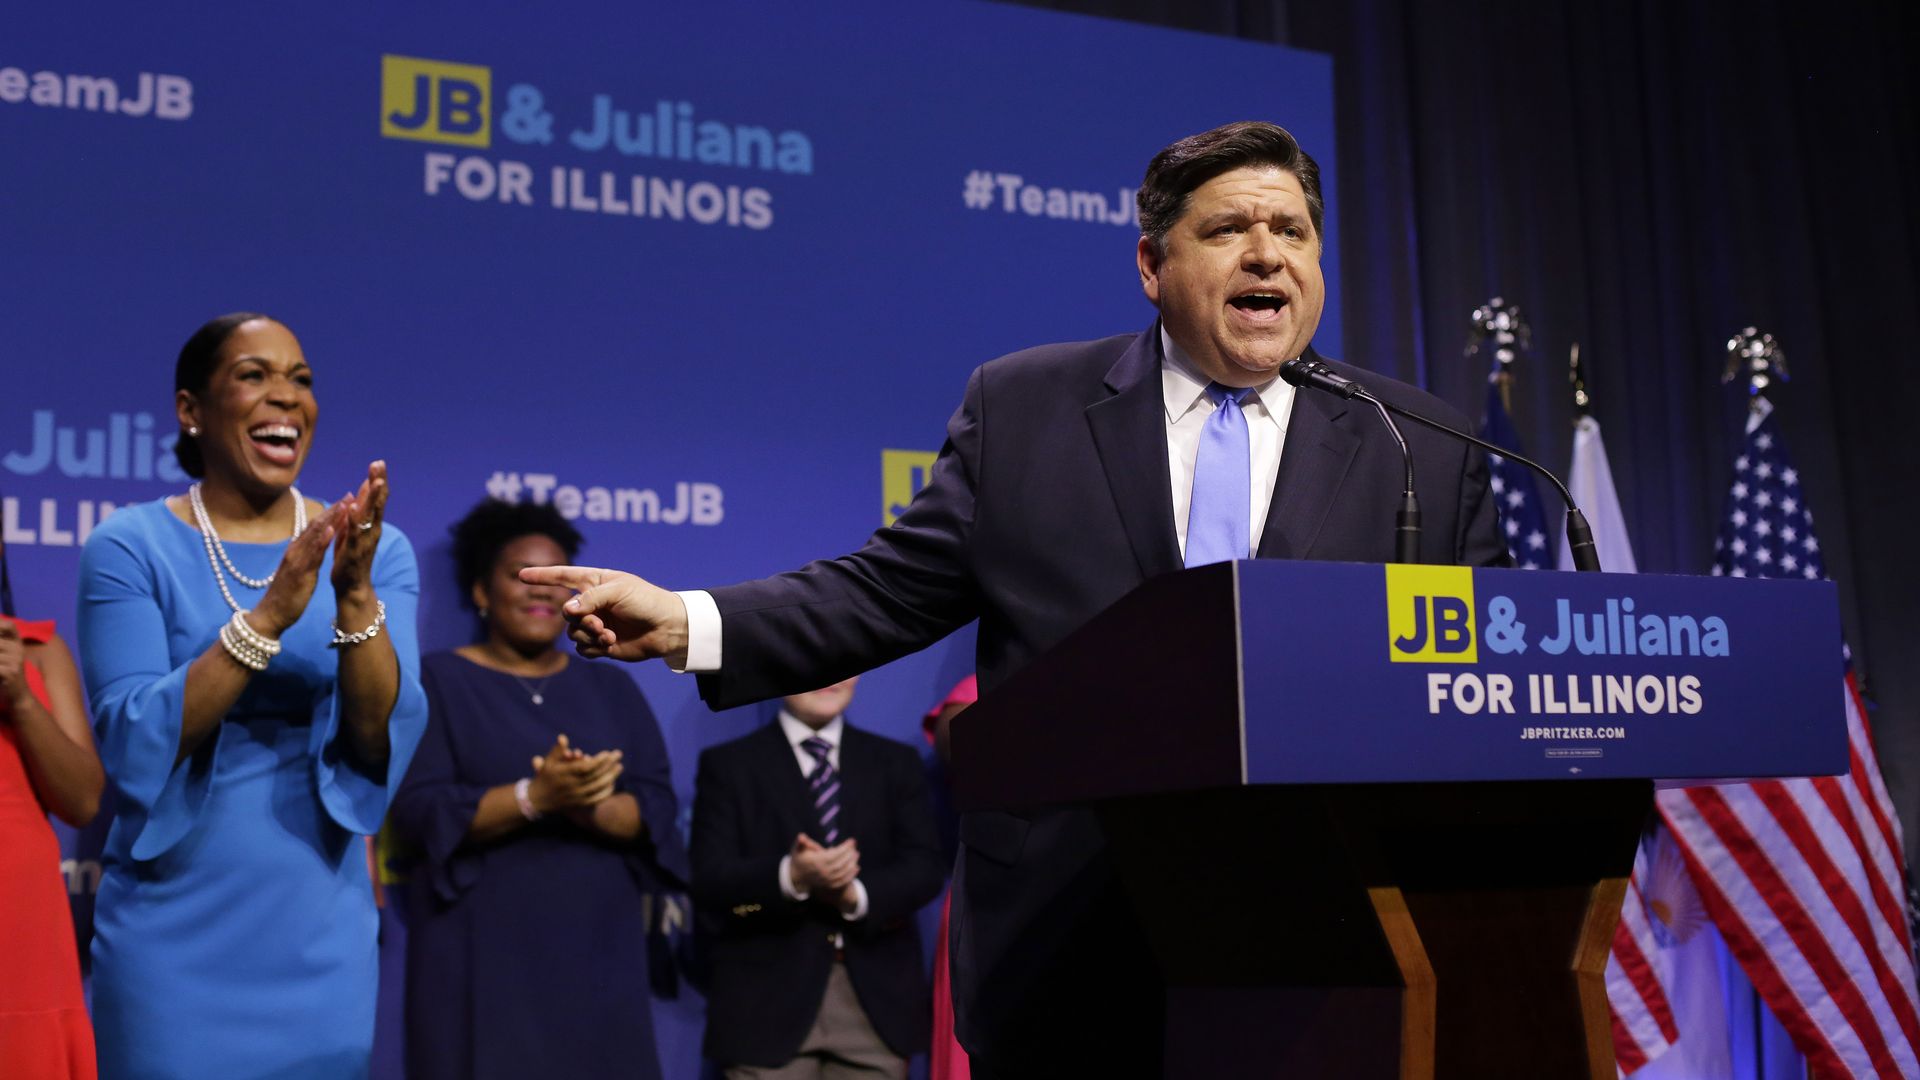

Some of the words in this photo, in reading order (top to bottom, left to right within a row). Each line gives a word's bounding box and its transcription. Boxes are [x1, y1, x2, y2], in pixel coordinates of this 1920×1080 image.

[388, 74, 484, 134] JB
[501, 82, 553, 145] &
[570, 94, 813, 174] Juliana
[424, 153, 533, 205] FOR
[551, 166, 774, 230] ILLINOIS
[963, 171, 1140, 226] #TeamJ
[1395, 596, 1470, 653] JB
[1485, 596, 1527, 654] &
[1539, 597, 1730, 657] Juliana
[1428, 673, 1515, 713] FOR
[1529, 675, 1702, 714] ILLINOIS
[1520, 727, 1625, 739] JBPRITZKER.COM
